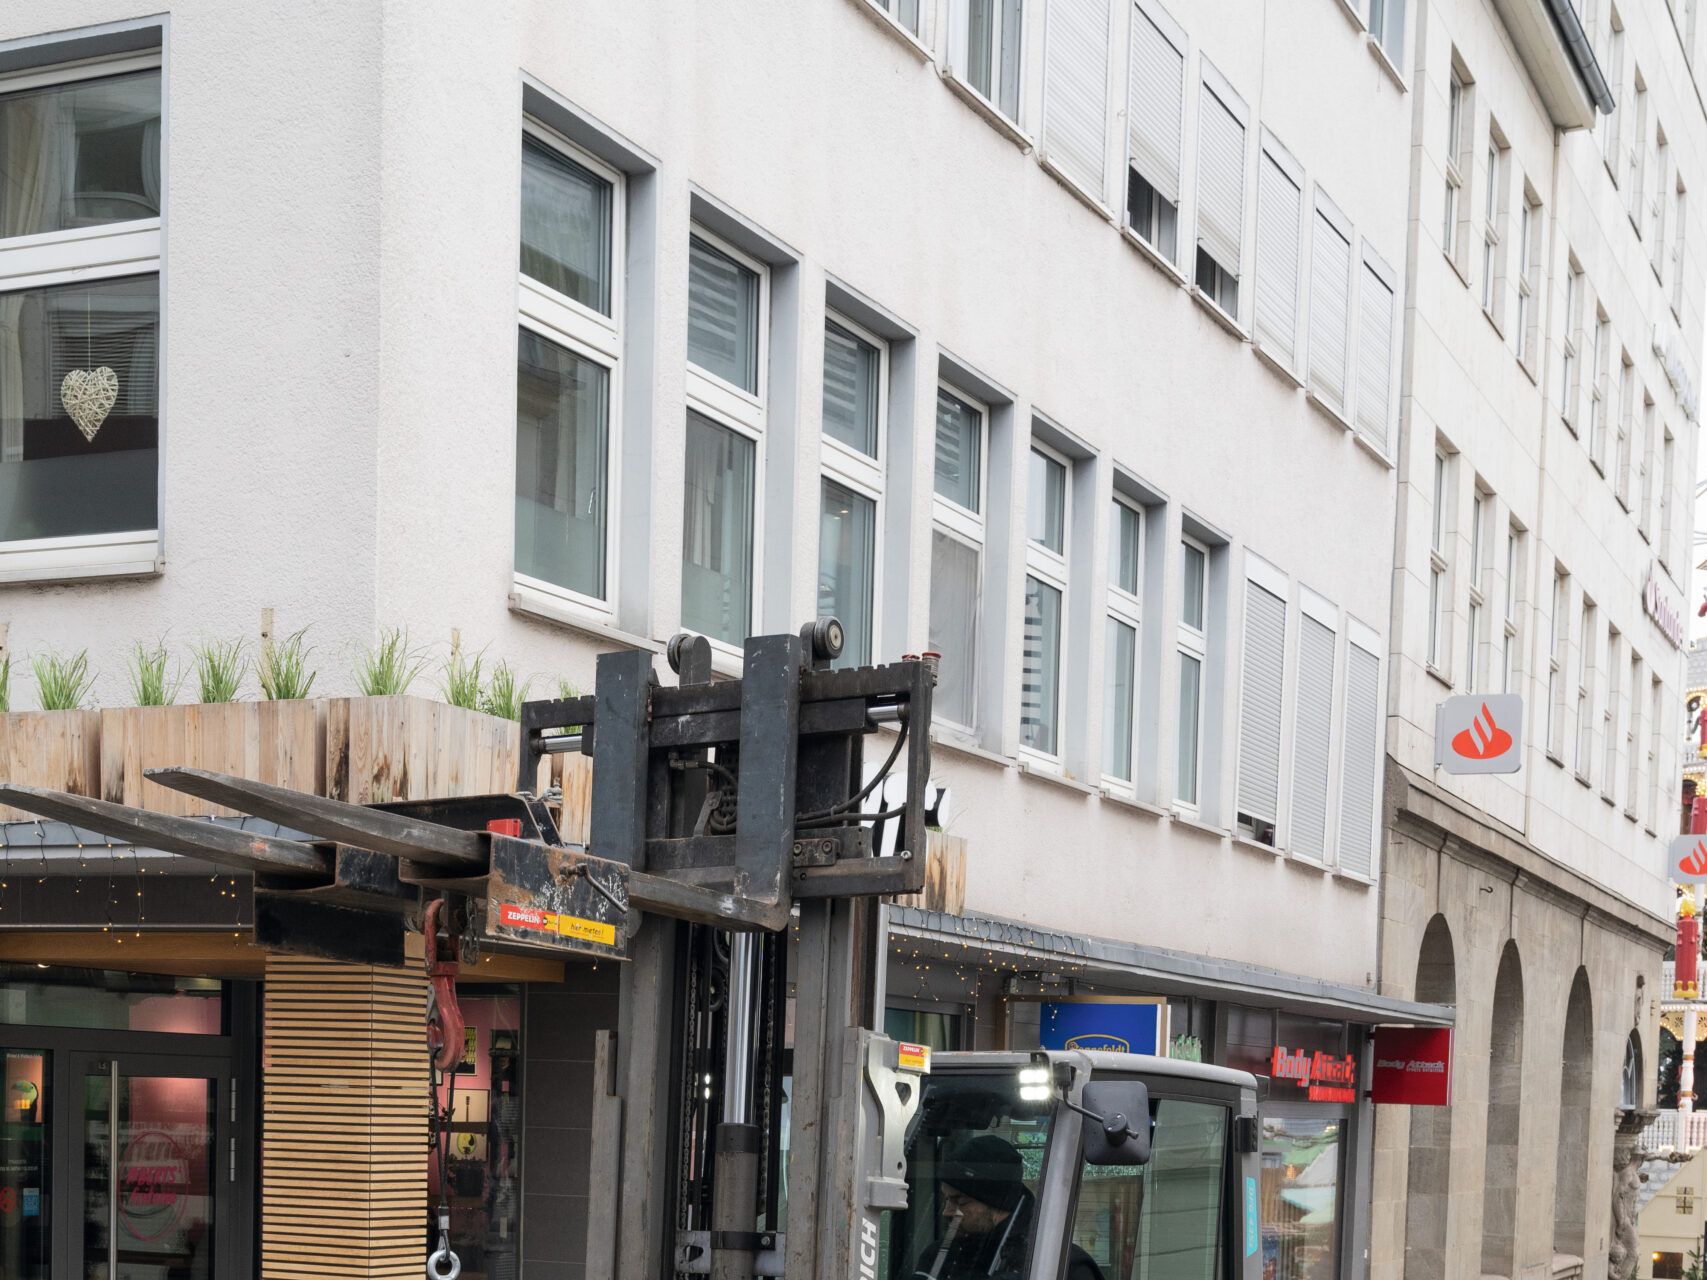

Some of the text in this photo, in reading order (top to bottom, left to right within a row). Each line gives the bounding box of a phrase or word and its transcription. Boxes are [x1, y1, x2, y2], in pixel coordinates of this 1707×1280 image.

[507, 911, 541, 925] ZEPPELIN
[1273, 1045, 1356, 1088] Body Attack
[1377, 1059, 1405, 1070] Body
